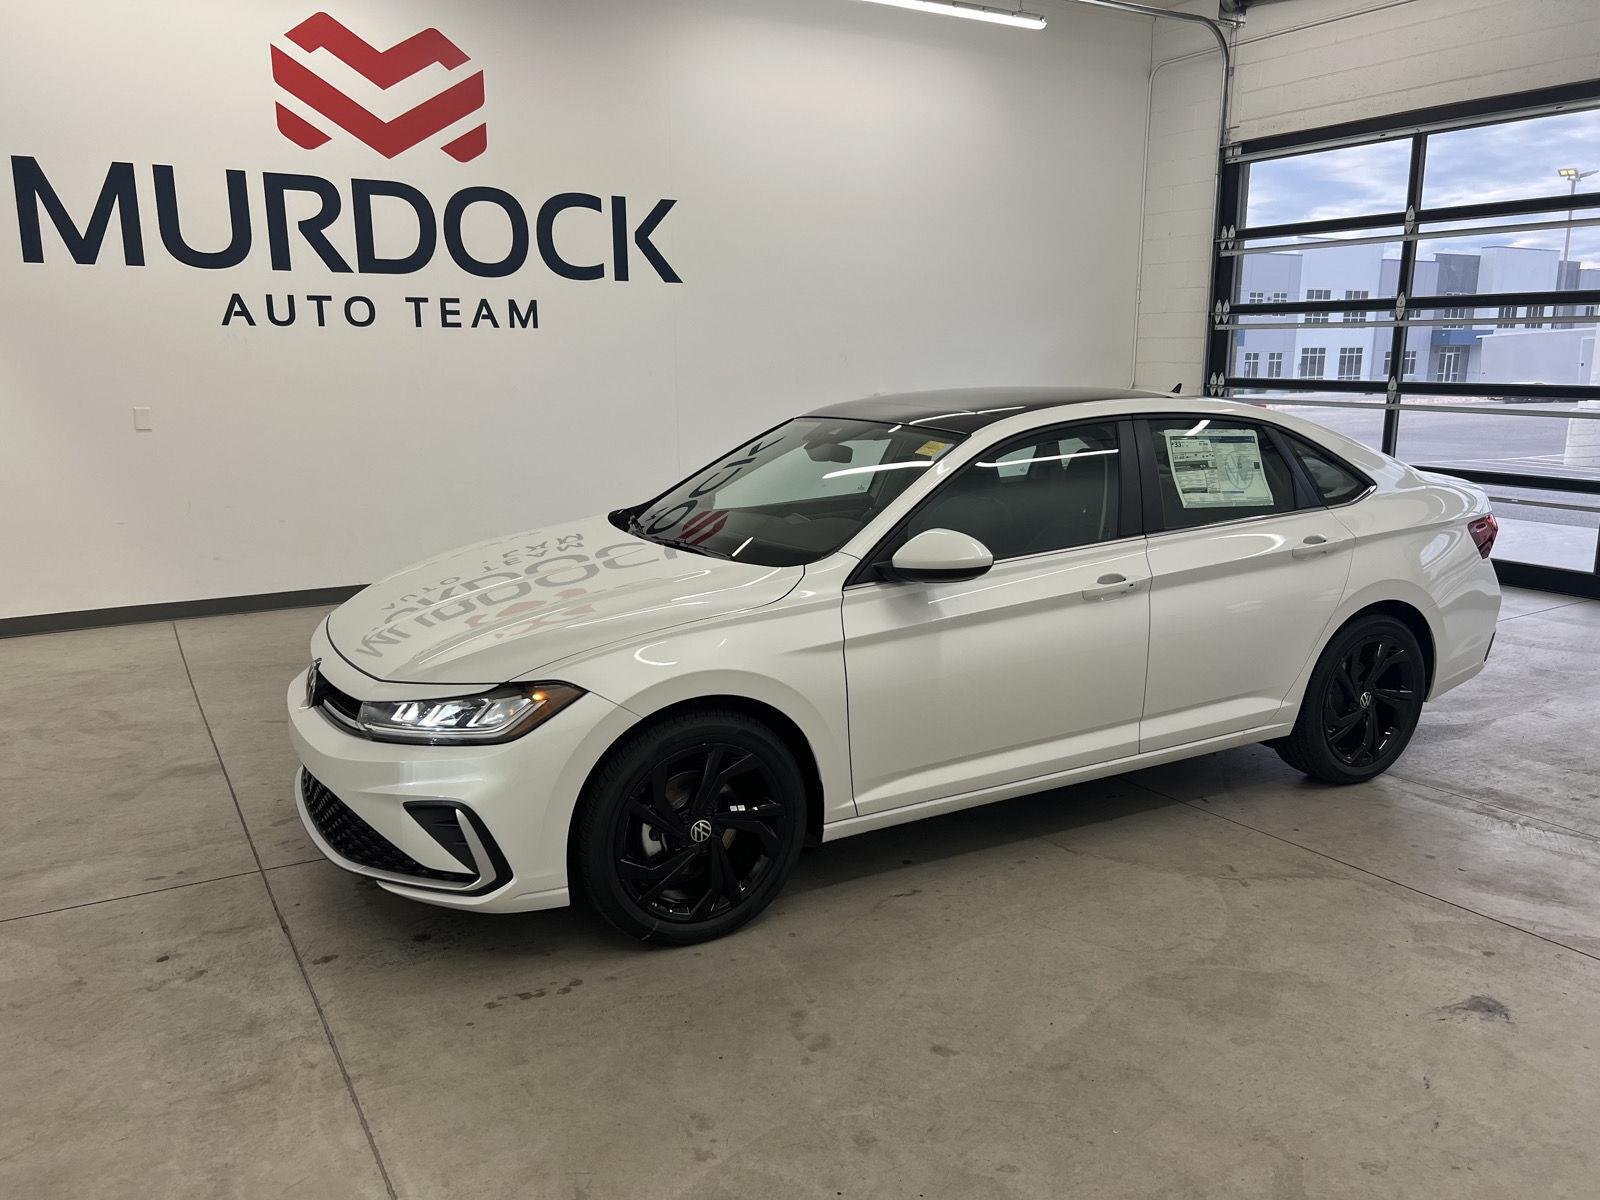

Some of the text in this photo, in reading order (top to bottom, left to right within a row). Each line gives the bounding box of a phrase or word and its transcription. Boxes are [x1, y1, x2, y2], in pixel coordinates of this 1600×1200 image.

[11, 155, 683, 283] MURDOCK
[221, 293, 539, 329] AUTO TEAM
